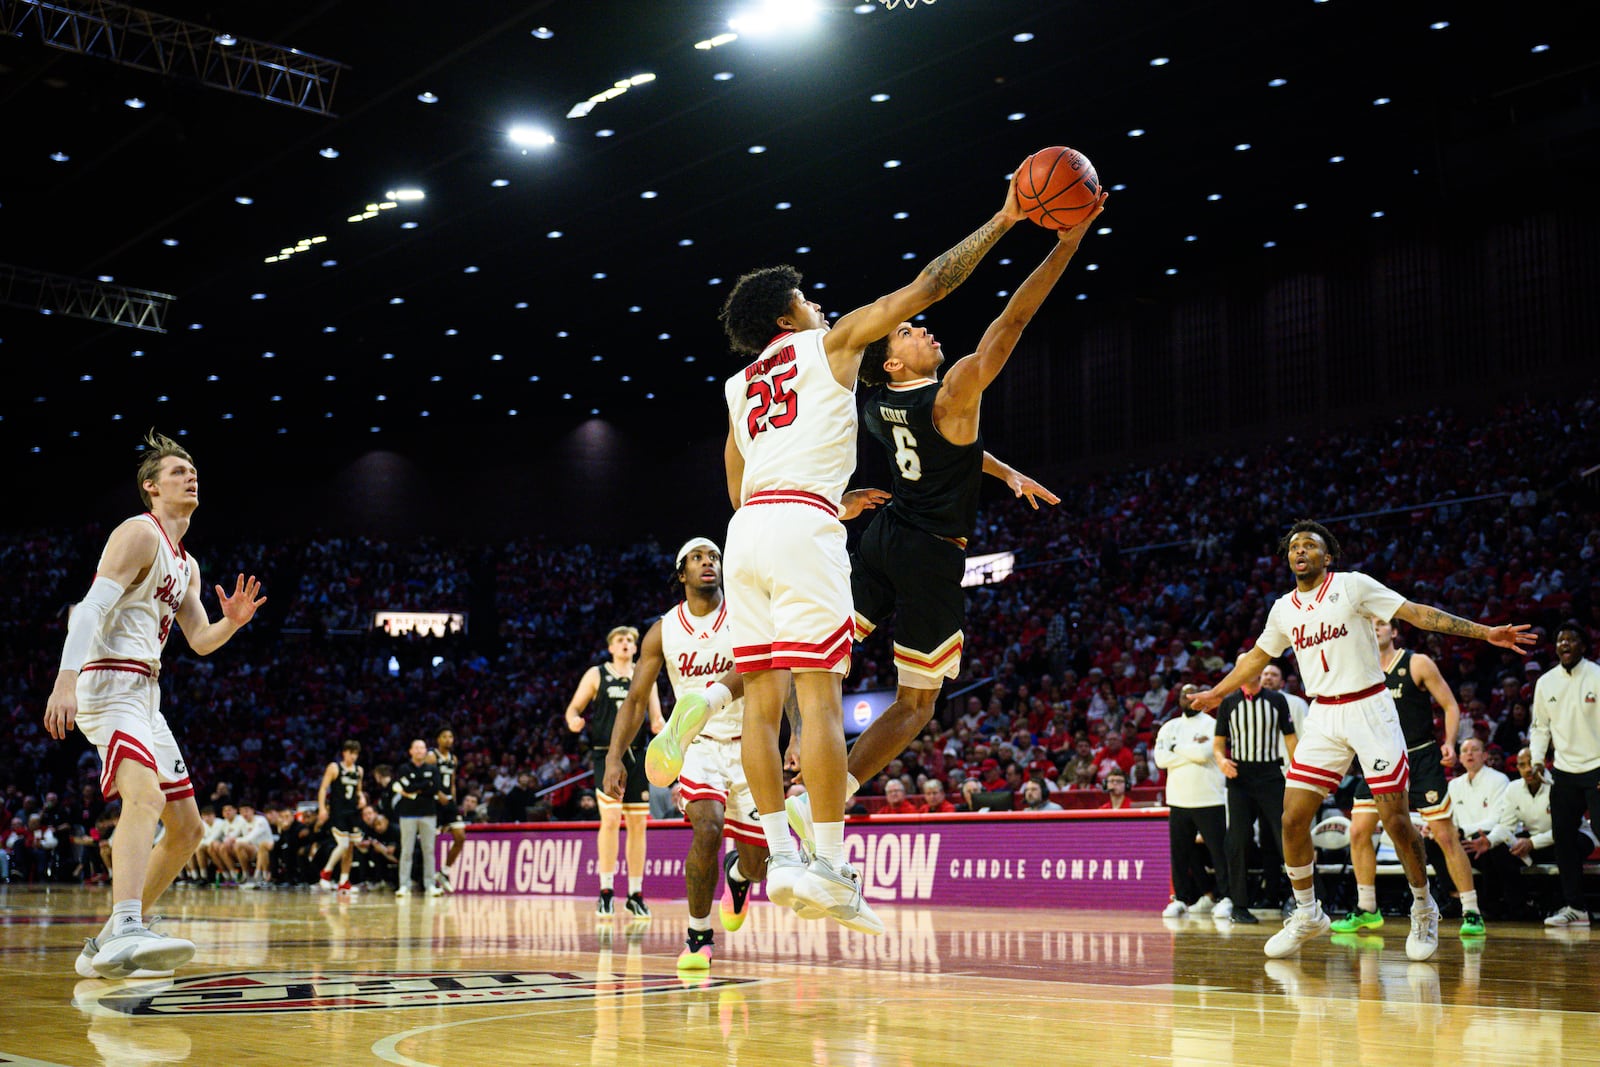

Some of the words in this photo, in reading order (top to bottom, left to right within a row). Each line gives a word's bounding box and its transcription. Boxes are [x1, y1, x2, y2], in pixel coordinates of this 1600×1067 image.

[746, 364, 797, 440] 25
[879, 406, 909, 425] KIRBY
[892, 425, 922, 481] 6
[1292, 622, 1348, 651] Huskies
[1320, 649, 1329, 673] 1
[441, 840, 511, 892] WARM
[515, 838, 582, 893] GLOW
[844, 833, 941, 900] GLOW
[949, 859, 1027, 879] CANDLE
[1041, 859, 1144, 880] COMPANY
